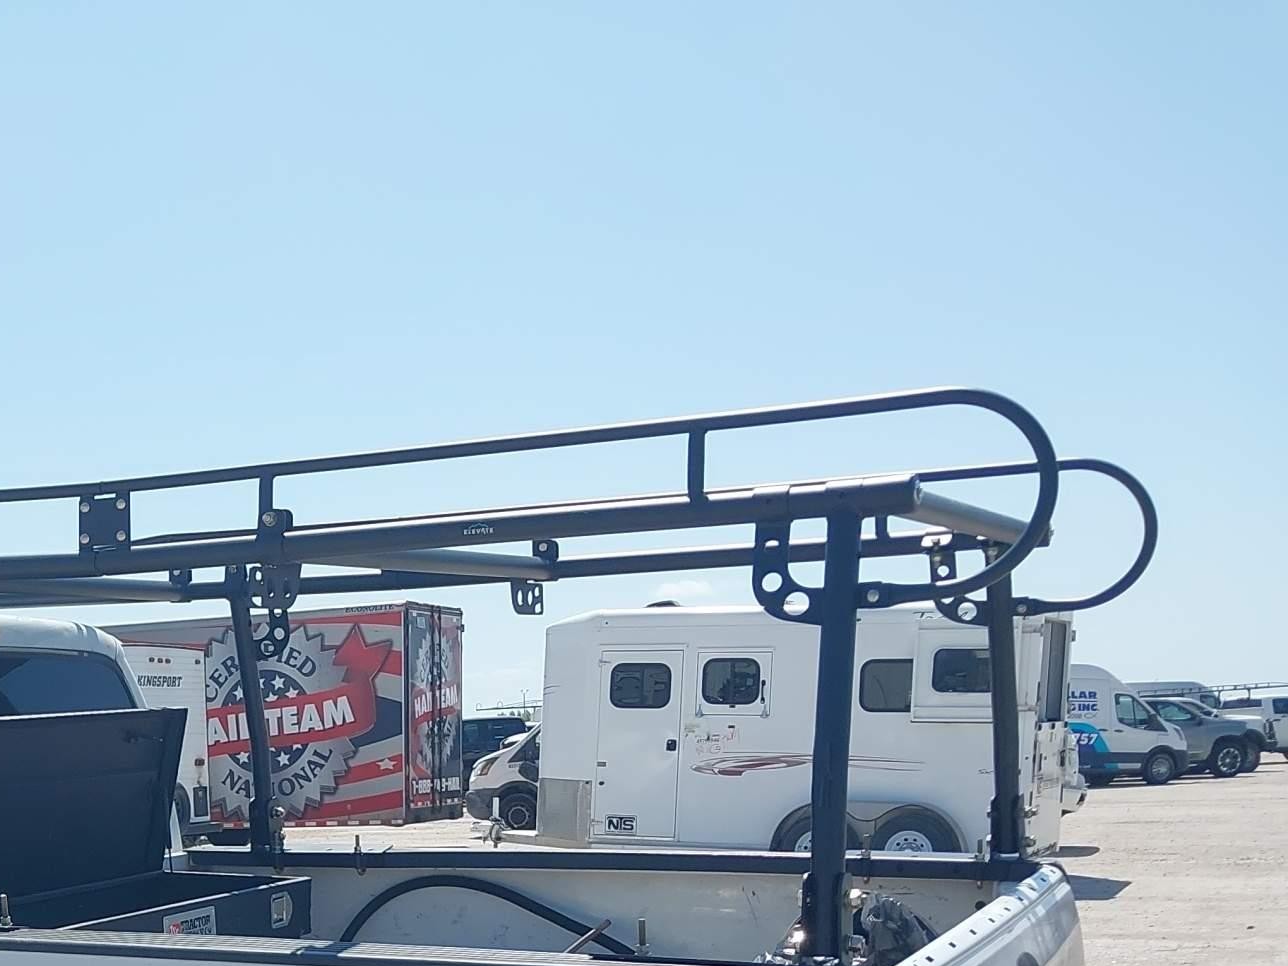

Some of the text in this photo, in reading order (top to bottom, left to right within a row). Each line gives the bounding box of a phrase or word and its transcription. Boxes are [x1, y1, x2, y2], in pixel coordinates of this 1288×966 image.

[137, 674, 183, 688] KINGSPORT
[1070, 690, 1098, 700] LAR
[264, 695, 356, 737] TEAM
[221, 748, 334, 798] NAIONAL
[606, 816, 636, 831] NTS
